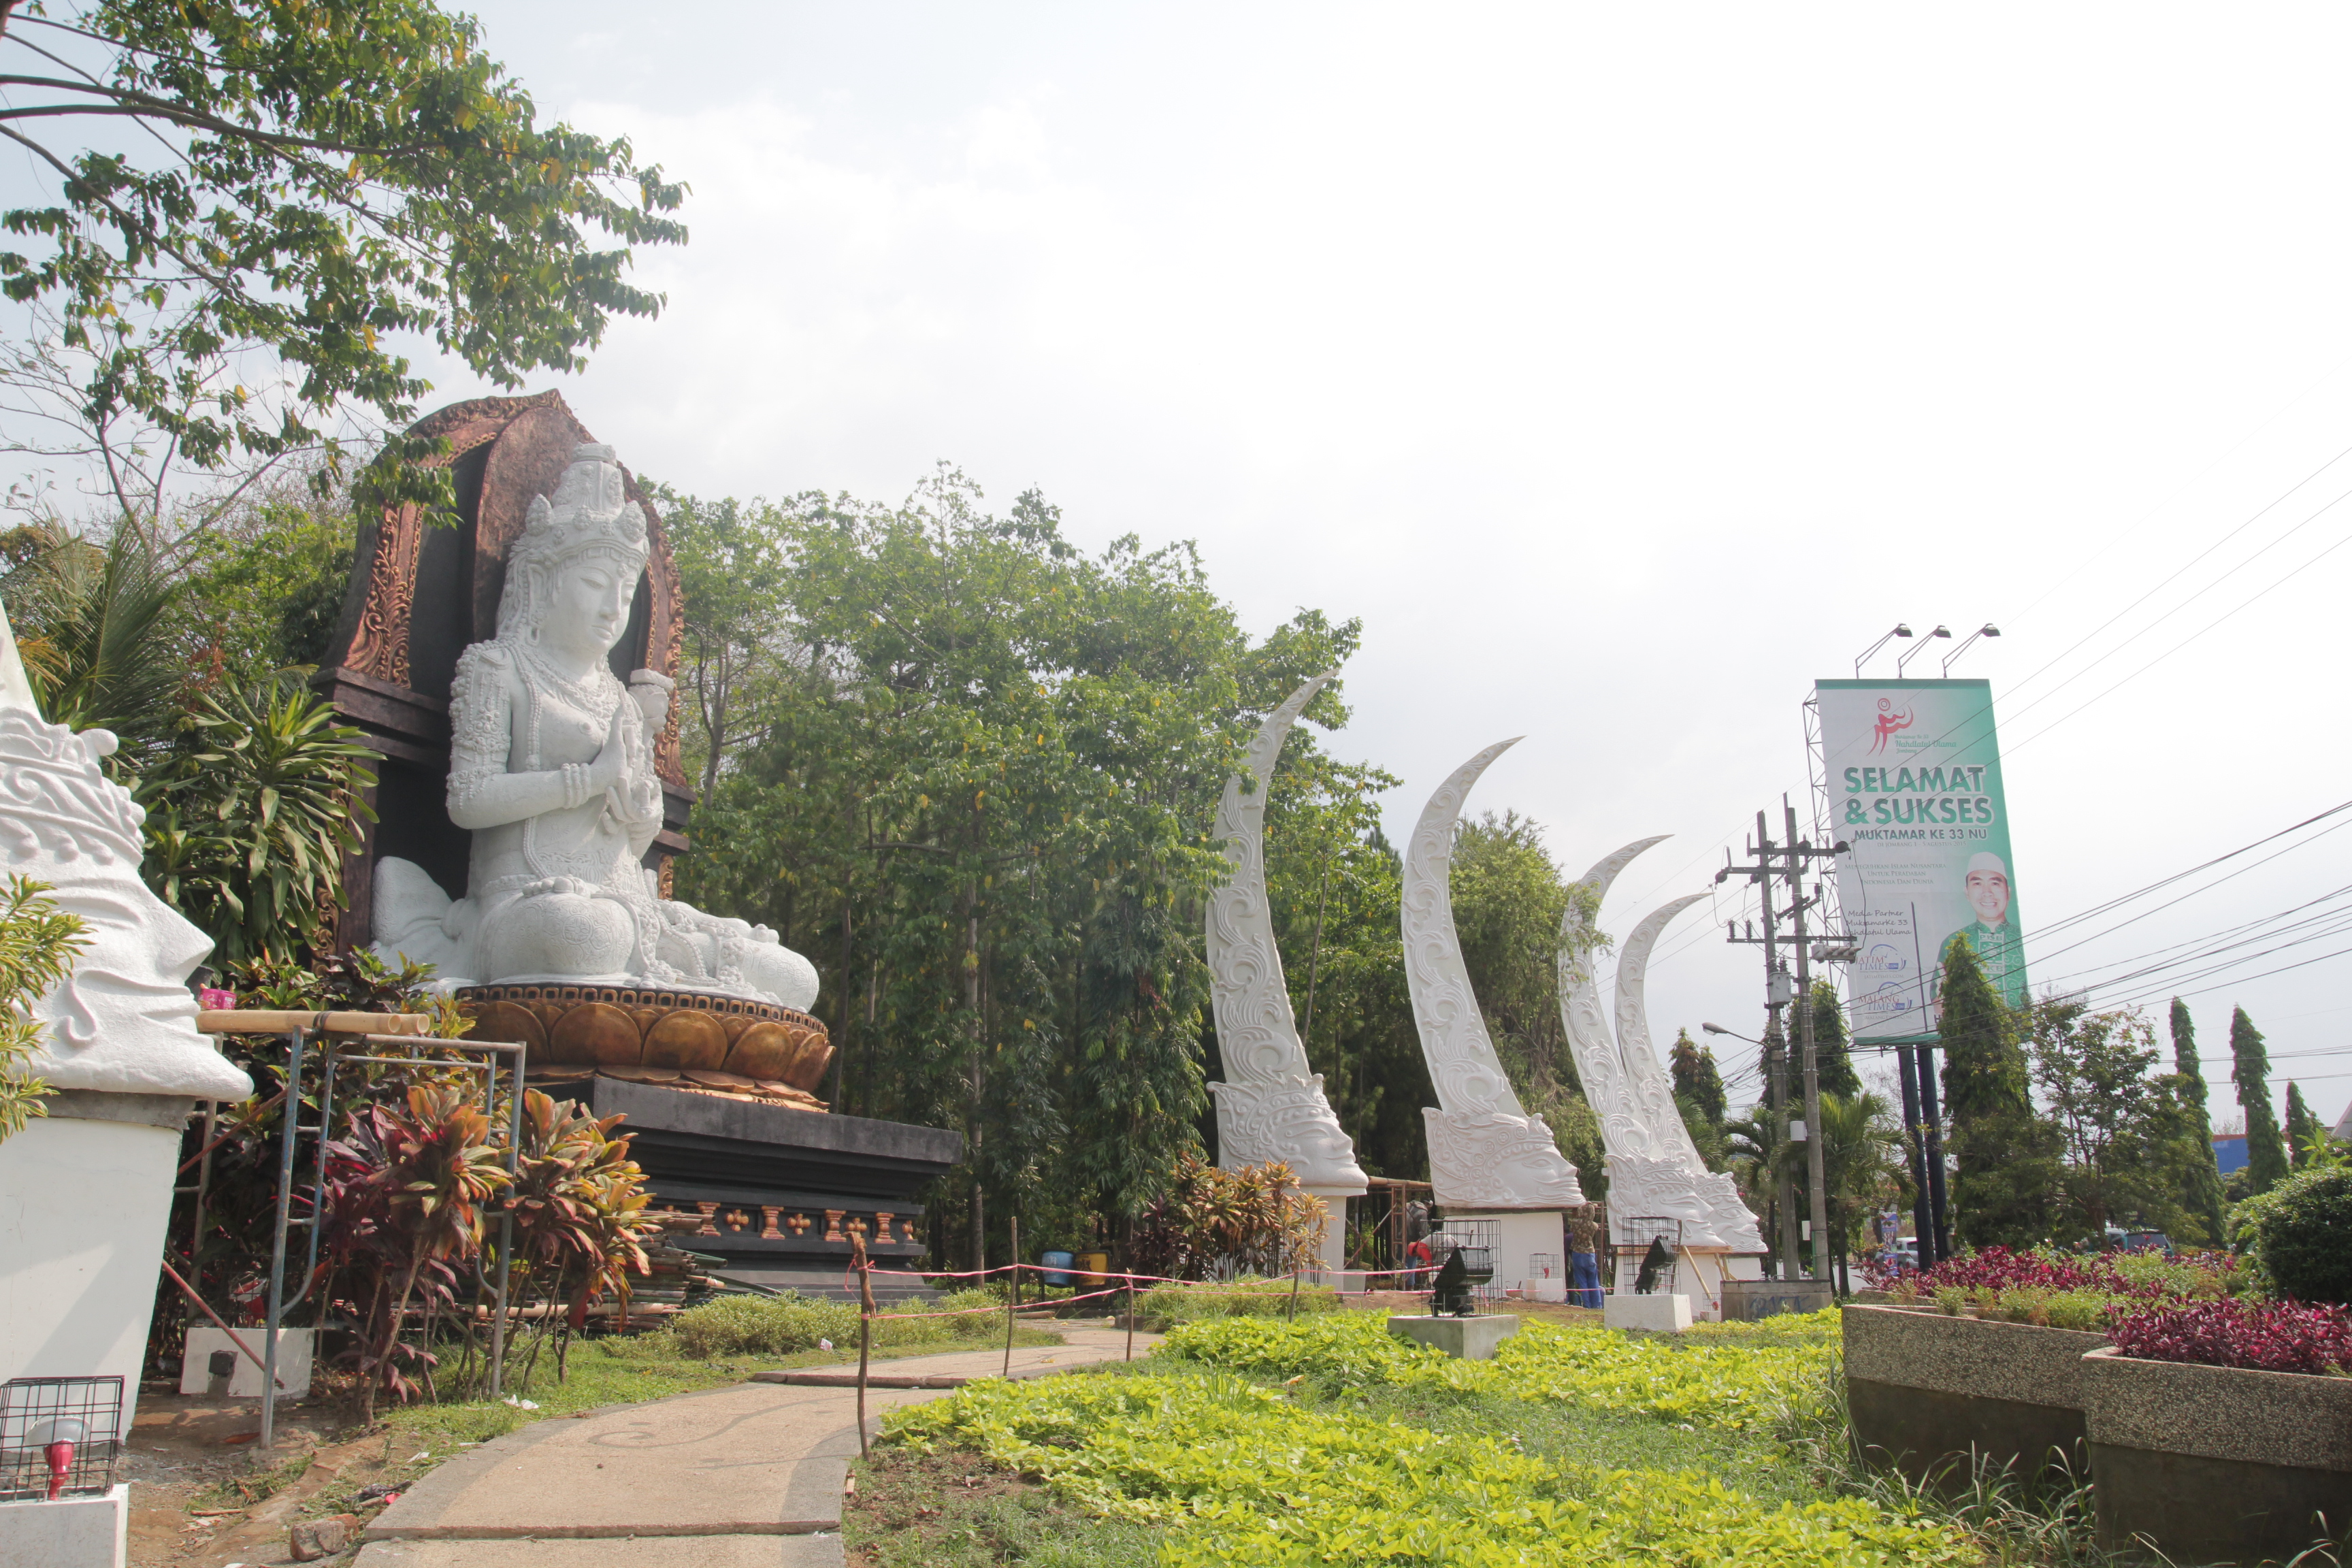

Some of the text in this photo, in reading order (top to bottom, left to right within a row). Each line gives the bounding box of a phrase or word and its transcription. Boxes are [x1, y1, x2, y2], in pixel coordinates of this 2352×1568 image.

[1895, 740, 1930, 748] Nahdlatul
[1844, 767, 1984, 793] SELAMAT
[1844, 798, 1992, 824] & SUKSES
[1855, 828, 1987, 840] MUKTAMAR KE 33 NU
[1855, 956, 1884, 964] JATIM
[1859, 995, 1899, 1003] MALANG
